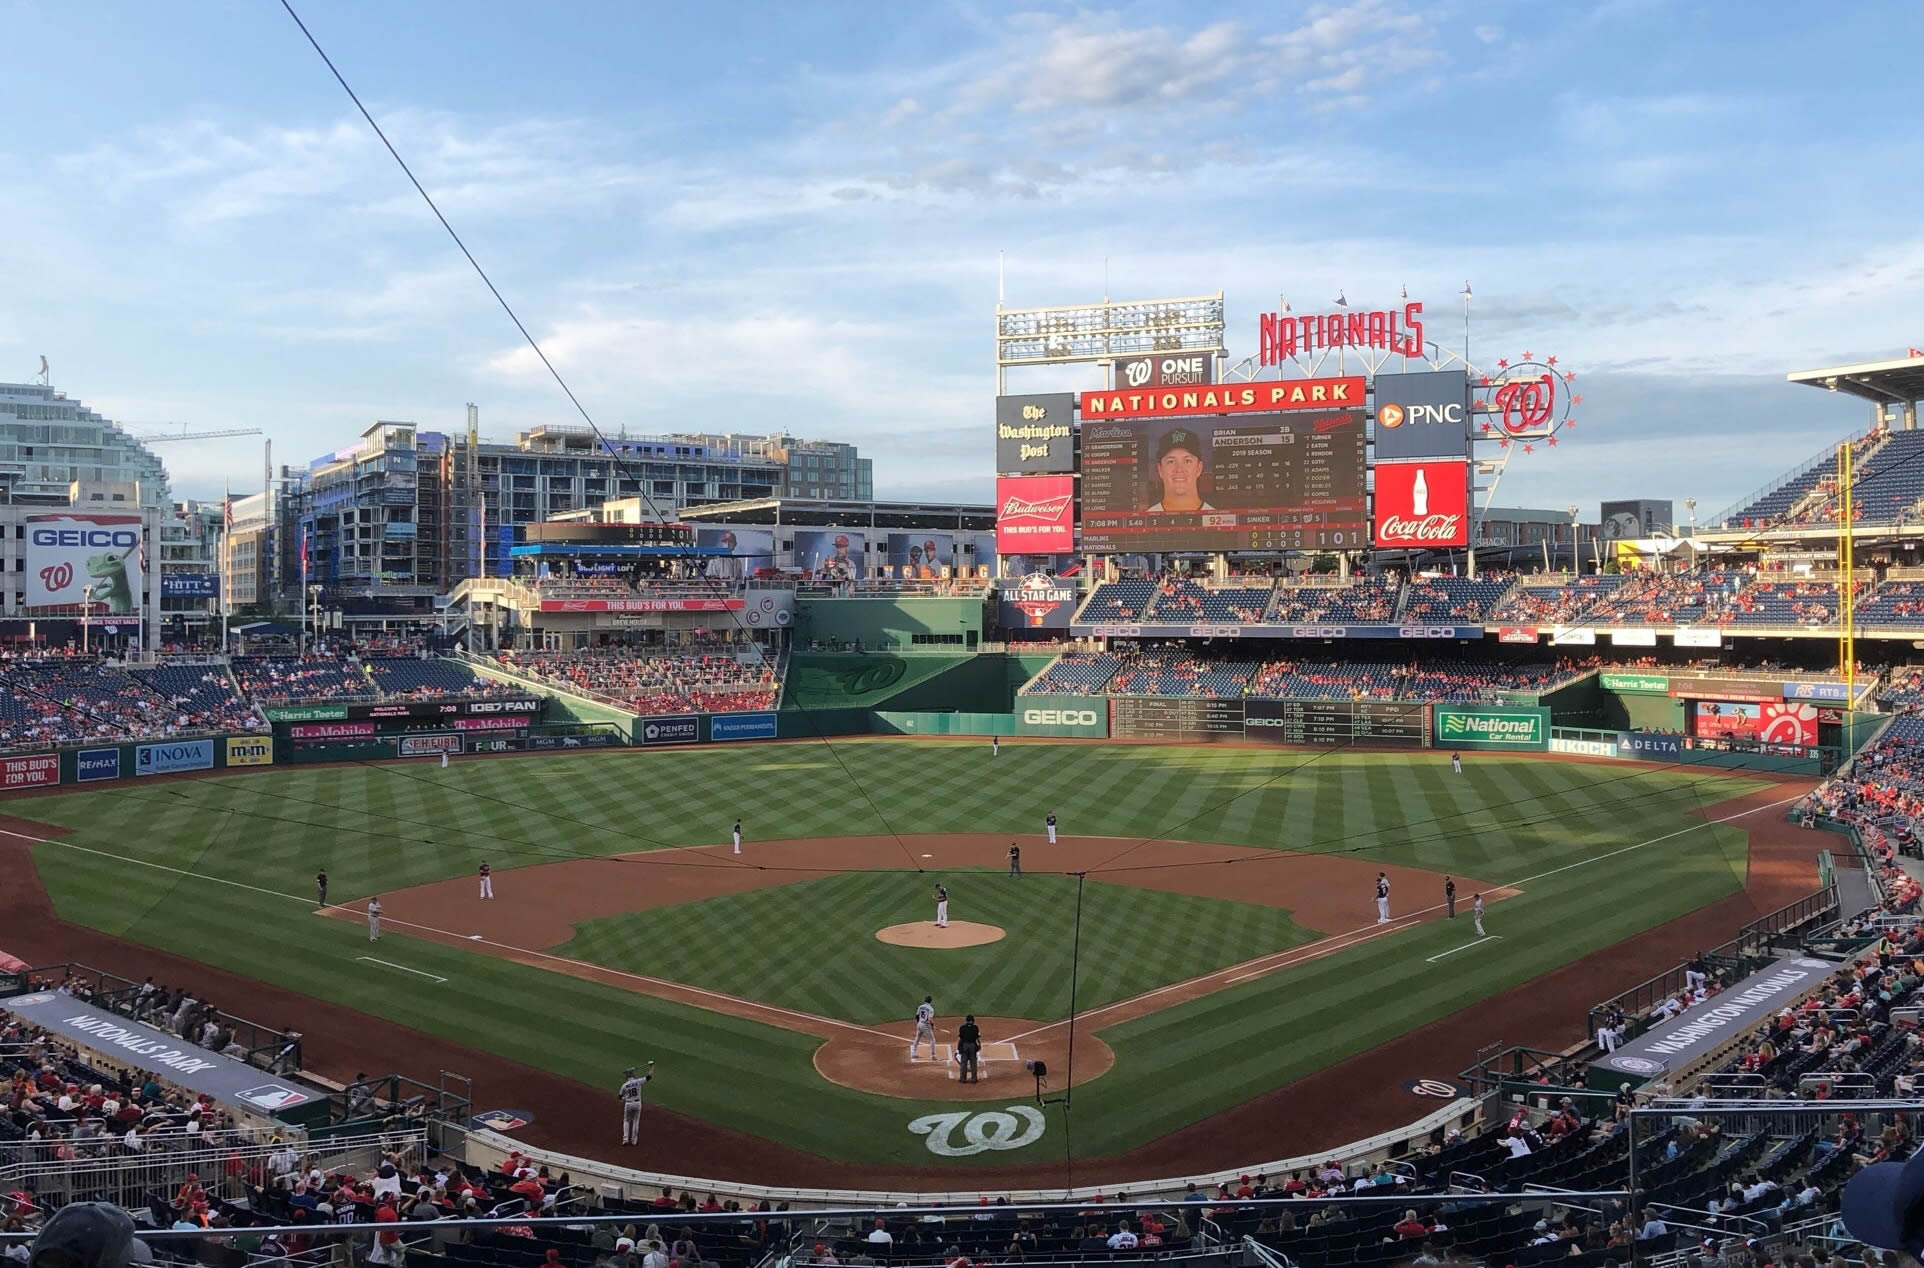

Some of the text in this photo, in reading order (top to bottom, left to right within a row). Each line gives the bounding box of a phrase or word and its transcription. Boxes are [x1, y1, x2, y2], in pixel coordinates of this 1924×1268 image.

[1260, 303, 1423, 366] NATIONALS
[1161, 358, 1203, 374] ONE
[1161, 372, 1203, 385] PURSUIT
[1090, 384, 1350, 413] NATIONALS PARK
[1022, 405, 1046, 419] The
[1406, 403, 1462, 424] PNC
[998, 423, 1070, 440] Washington
[1089, 426, 1132, 440] Marlins
[1214, 437, 1263, 446] ANDERSON
[1020, 443, 1049, 461] Post
[1003, 501, 1065, 514] Budweiser
[1209, 517, 1221, 525] 92
[1038, 525, 1051, 533] FOR
[1380, 514, 1464, 541] Coca-Cola
[33, 529, 137, 547] GEICO
[1266, 540, 1272, 548] 0
[1280, 540, 1286, 548] 0
[1319, 533, 1325, 544] 1
[1333, 532, 1344, 544] 0
[1352, 532, 1357, 544] 1
[594, 564, 615, 572] LIGHT
[617, 564, 635, 572] LOFT
[169, 581, 202, 590] HITT
[1003, 590, 1072, 601] ALL STAR GAME
[607, 601, 685, 611] THIS BUD'S FOR YOU.
[1092, 628, 1141, 636] GEICO
[1190, 627, 1241, 637] GEICO
[1292, 628, 1346, 637] GEICO
[1399, 628, 1455, 638] GEICO
[1612, 680, 1667, 690] Harris Teeter
[505, 701, 536, 711] FAN
[279, 711, 345, 719] Harris Teeter
[1024, 709, 1097, 725] GEICO
[1246, 718, 1284, 726] GEICO
[660, 725, 695, 733] PENFED
[536, 738, 555, 746] MGM
[1505, 733, 1531, 741] Rental
[1569, 742, 1611, 754] KOCH
[1634, 740, 1678, 752] DELTA
[155, 745, 202, 761] INOVA
[1809, 750, 1819, 759] 335
[5, 758, 57, 772] THIS BUD'S
[80, 758, 117, 770] RE/MAX
[6, 771, 48, 784] FOR YOU.
[1645, 969, 1809, 1056] WASHINGTON NATIONALS
[63, 1015, 216, 1075] NATIONALS PARK
